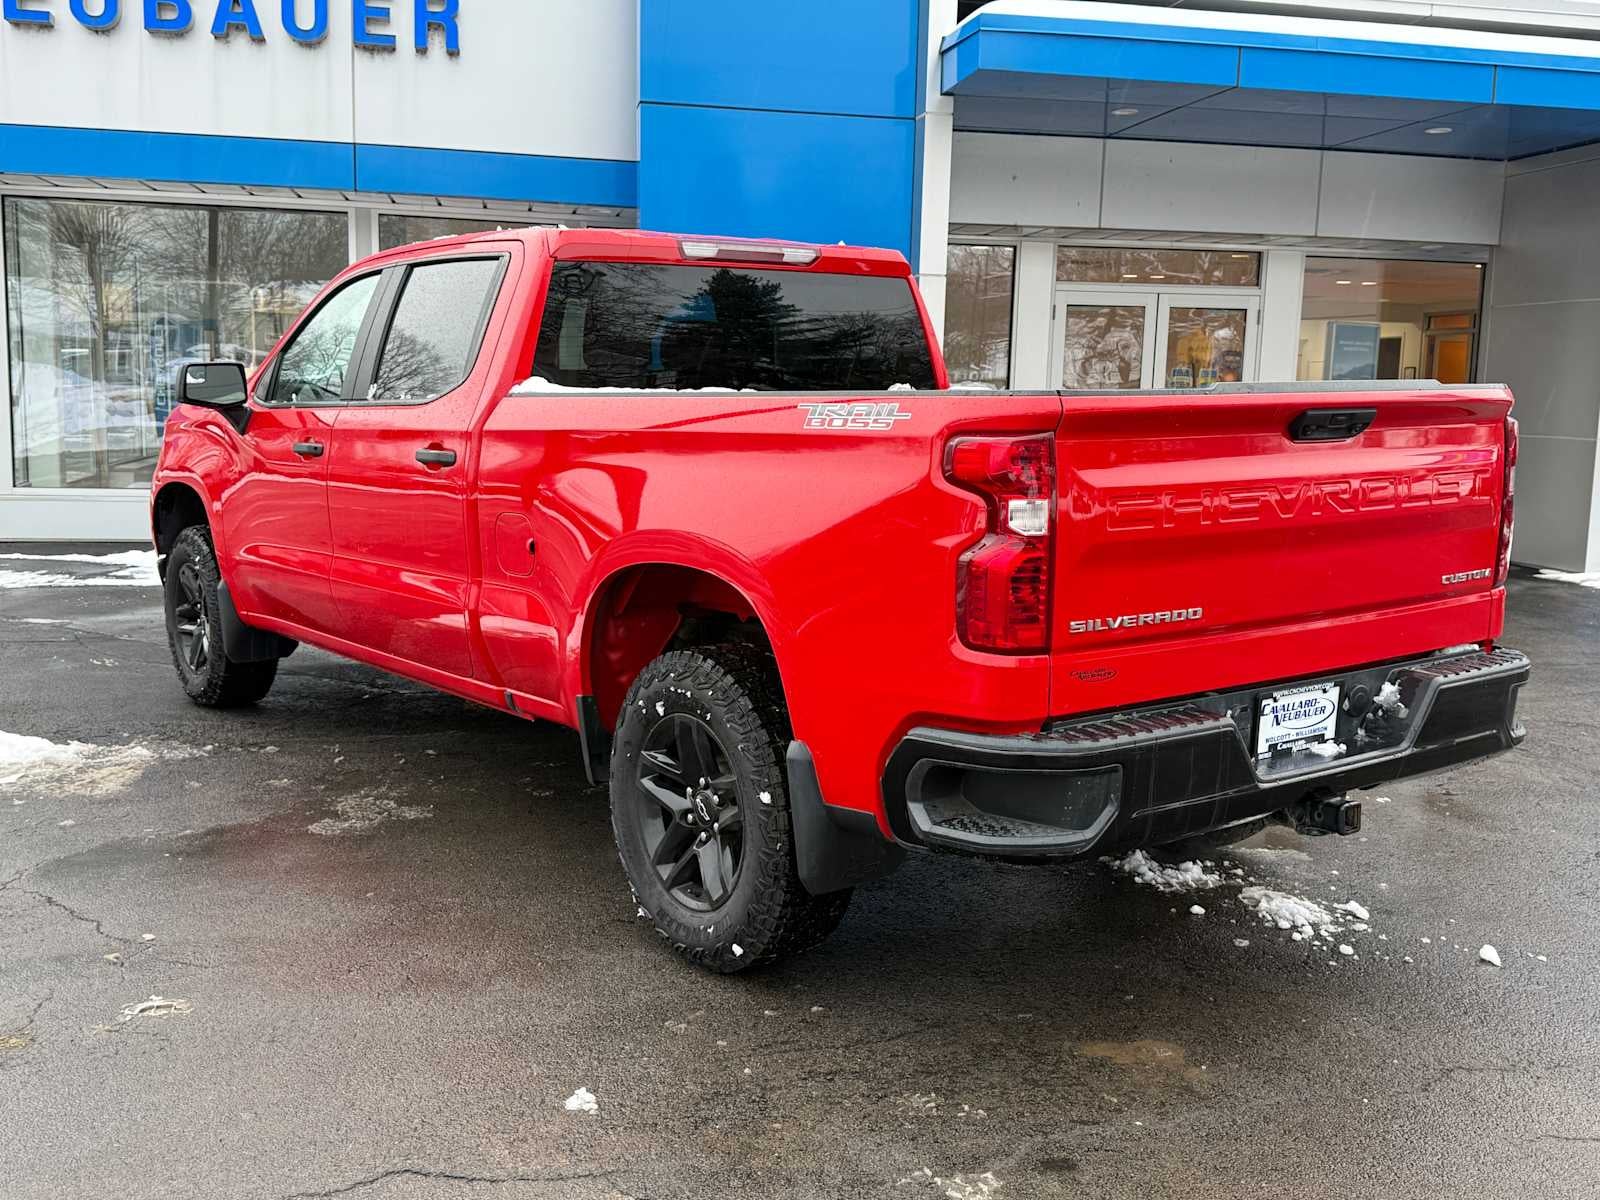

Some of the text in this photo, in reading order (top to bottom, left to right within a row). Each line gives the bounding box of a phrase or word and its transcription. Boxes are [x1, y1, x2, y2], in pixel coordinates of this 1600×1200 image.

[798, 403, 912, 419] TRAIL
[803, 418, 894, 431] BOSS
[1106, 468, 1491, 532] CHEVROLET
[1441, 568, 1492, 585] CUSTOM
[1069, 607, 1203, 634] SILVERADO
[1271, 705, 1327, 728] NEUBAUER
